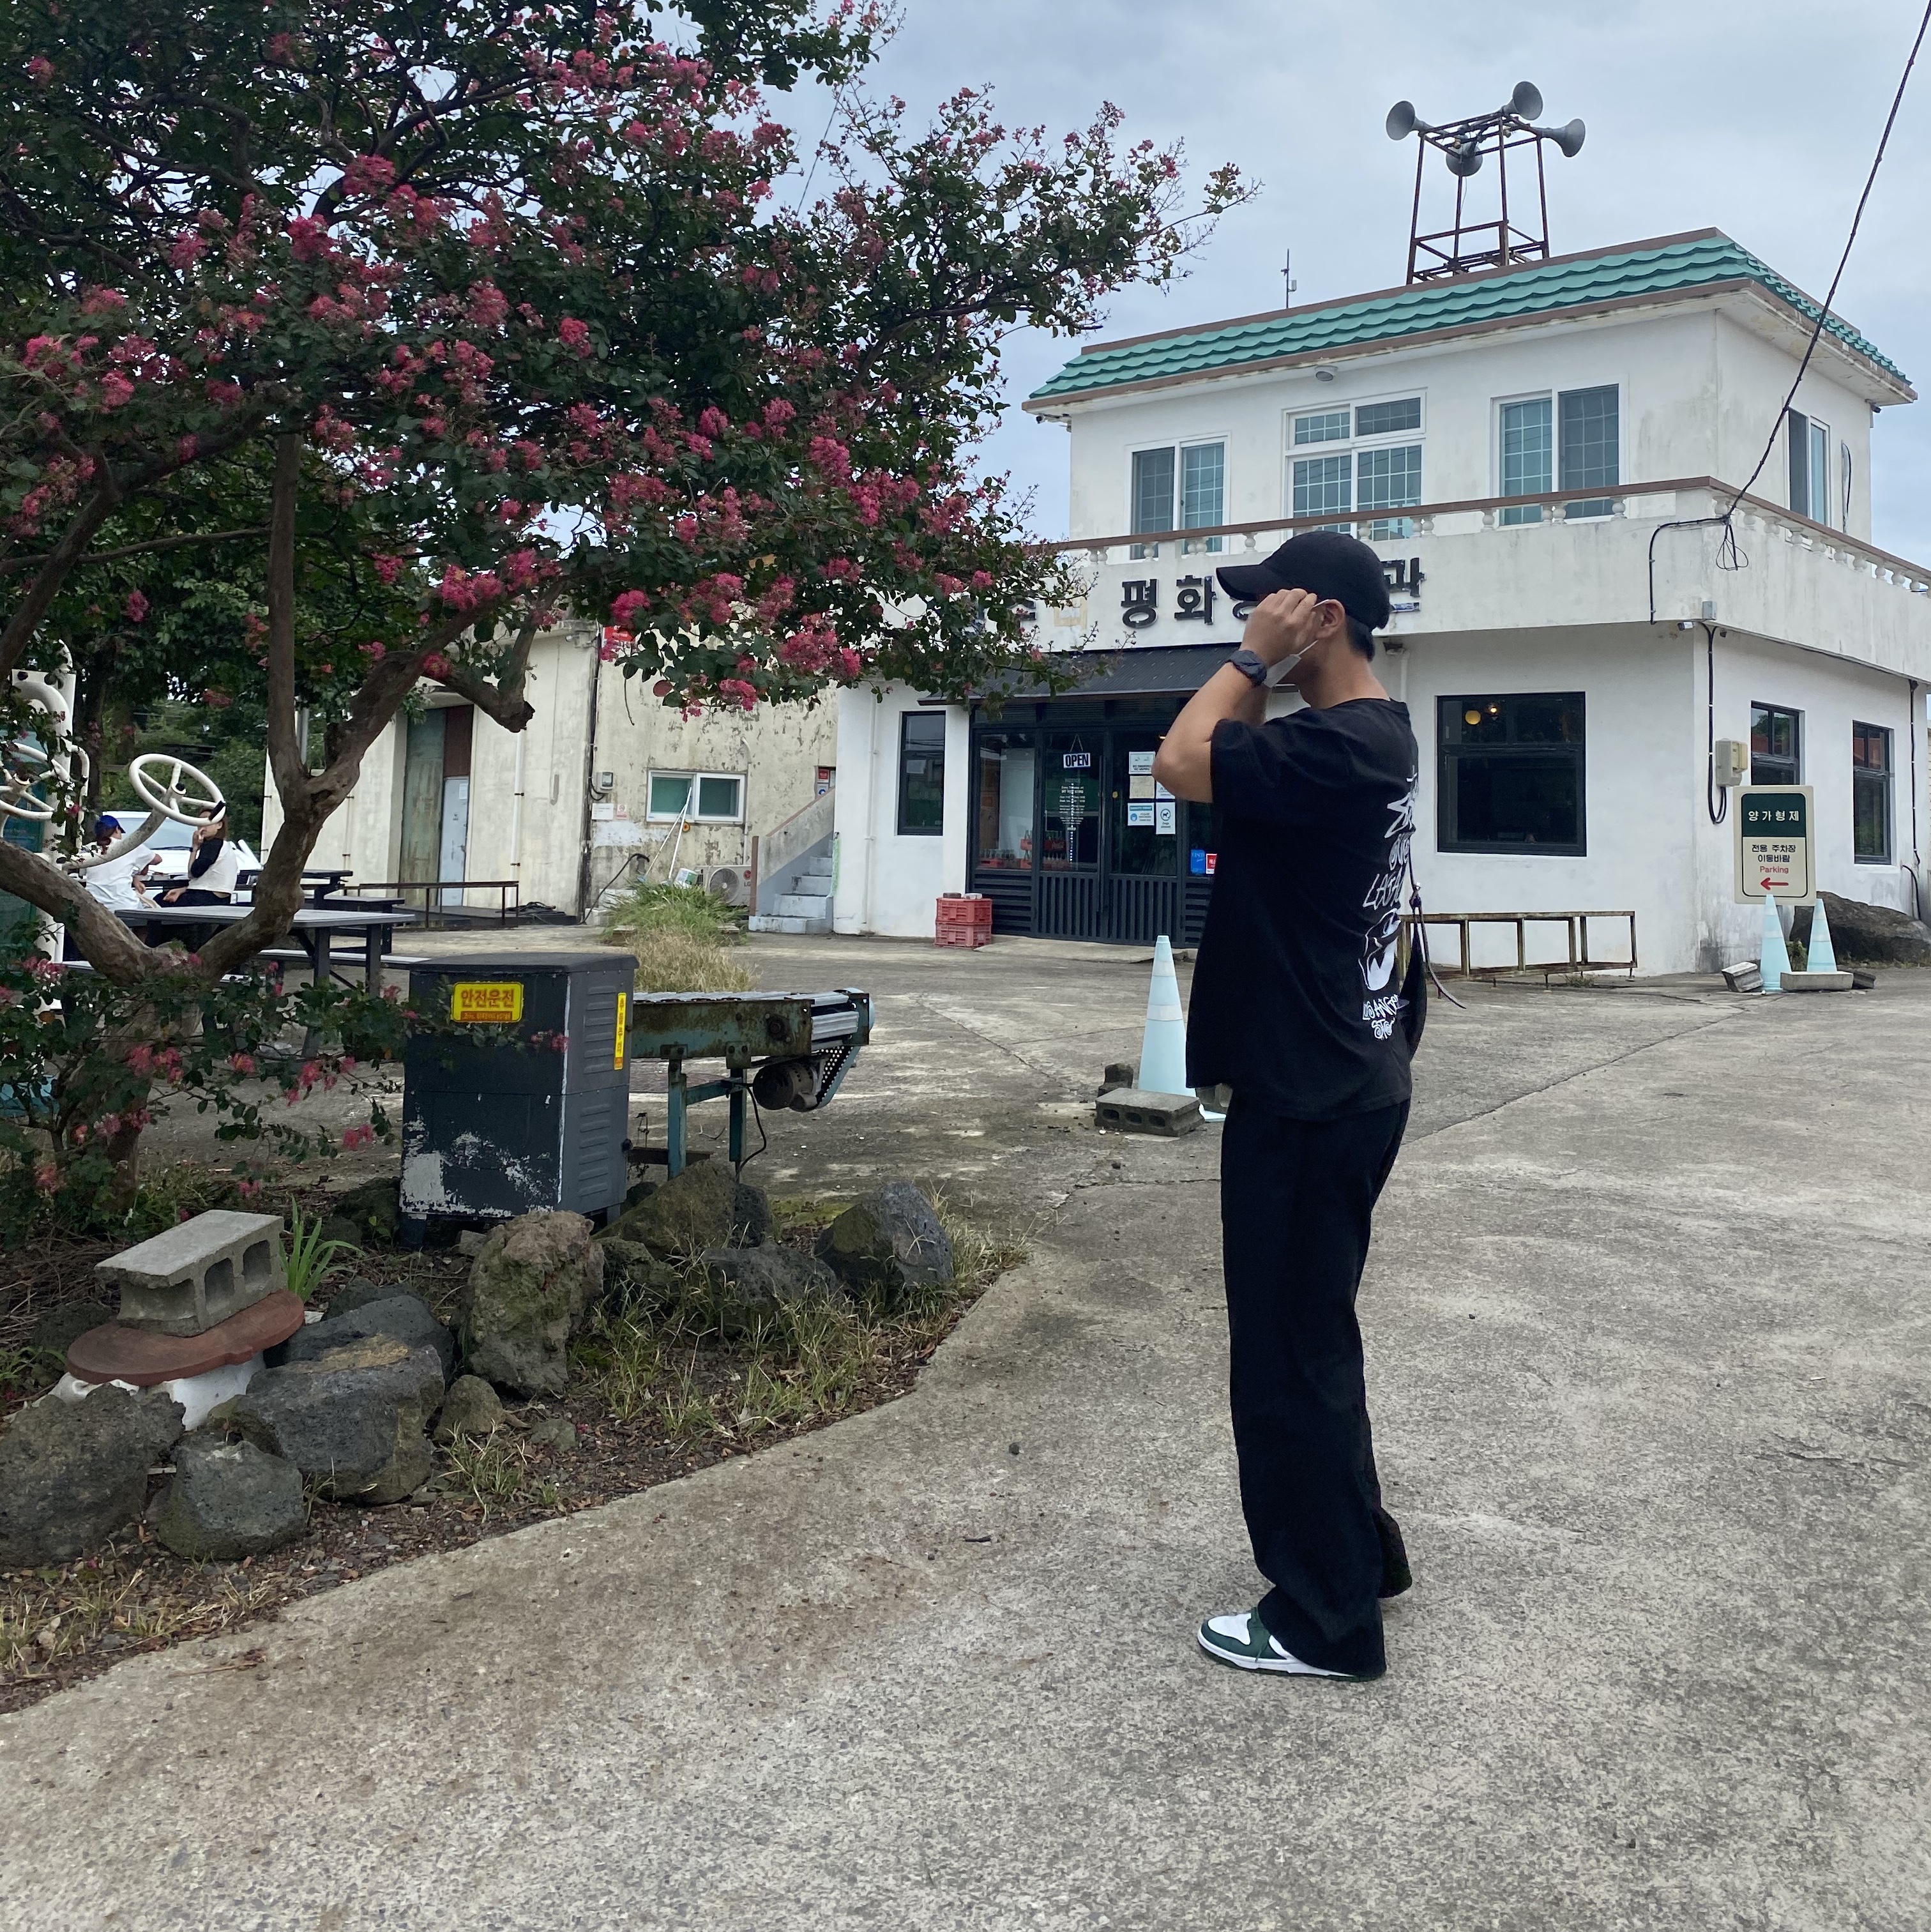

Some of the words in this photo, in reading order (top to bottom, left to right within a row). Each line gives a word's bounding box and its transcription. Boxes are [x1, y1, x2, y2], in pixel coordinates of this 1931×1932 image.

[1065, 754, 1089, 767] OPEN
[1748, 810, 1799, 822] 양가형제
[1772, 844, 1796, 853] 주차장
[1757, 855, 1791, 863] 이동바람
[1759, 865, 1789, 874] Parking
[460, 988, 515, 1008] 안전운전
